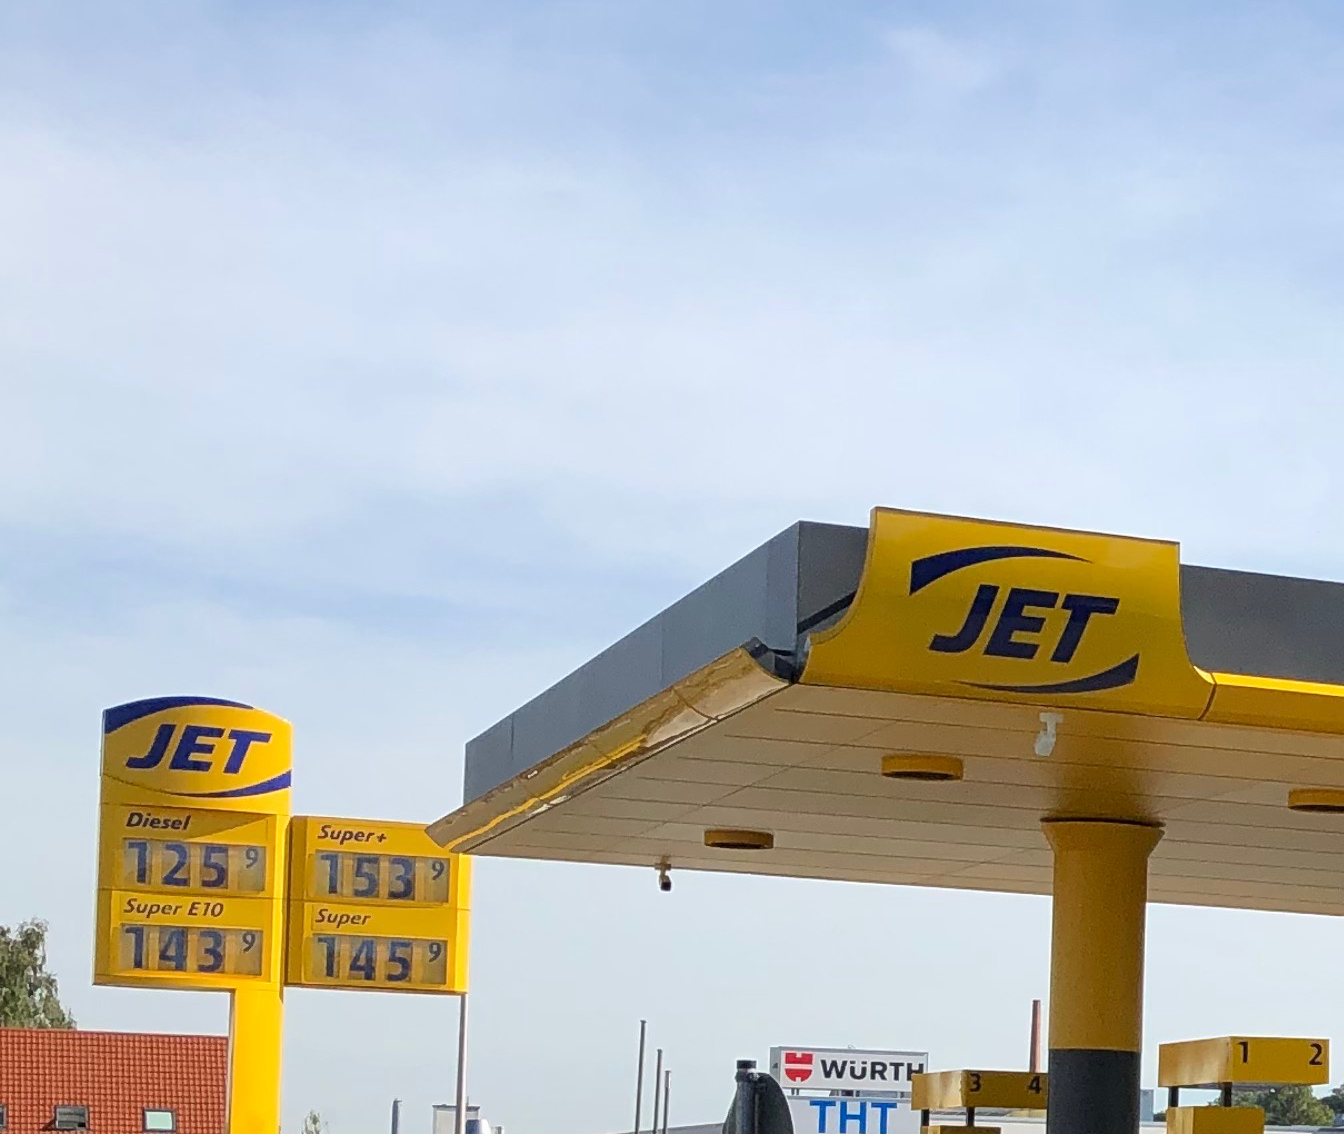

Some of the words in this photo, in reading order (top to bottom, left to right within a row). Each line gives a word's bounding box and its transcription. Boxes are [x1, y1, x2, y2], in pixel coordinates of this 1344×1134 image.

[929, 584, 1120, 663] JET
[125, 724, 272, 774] JET
[126, 812, 191, 830] Diesel
[124, 898, 182, 919] Super
[188, 902, 224, 917] E10
[315, 908, 371, 928] Super
[1238, 1041, 1249, 1063] 1
[1309, 1043, 1322, 1065] 2
[820, 1059, 924, 1082] WÜRTH
[969, 1073, 981, 1092] 3
[1028, 1075, 1042, 1094] 4
[810, 1100, 897, 1134] THT
